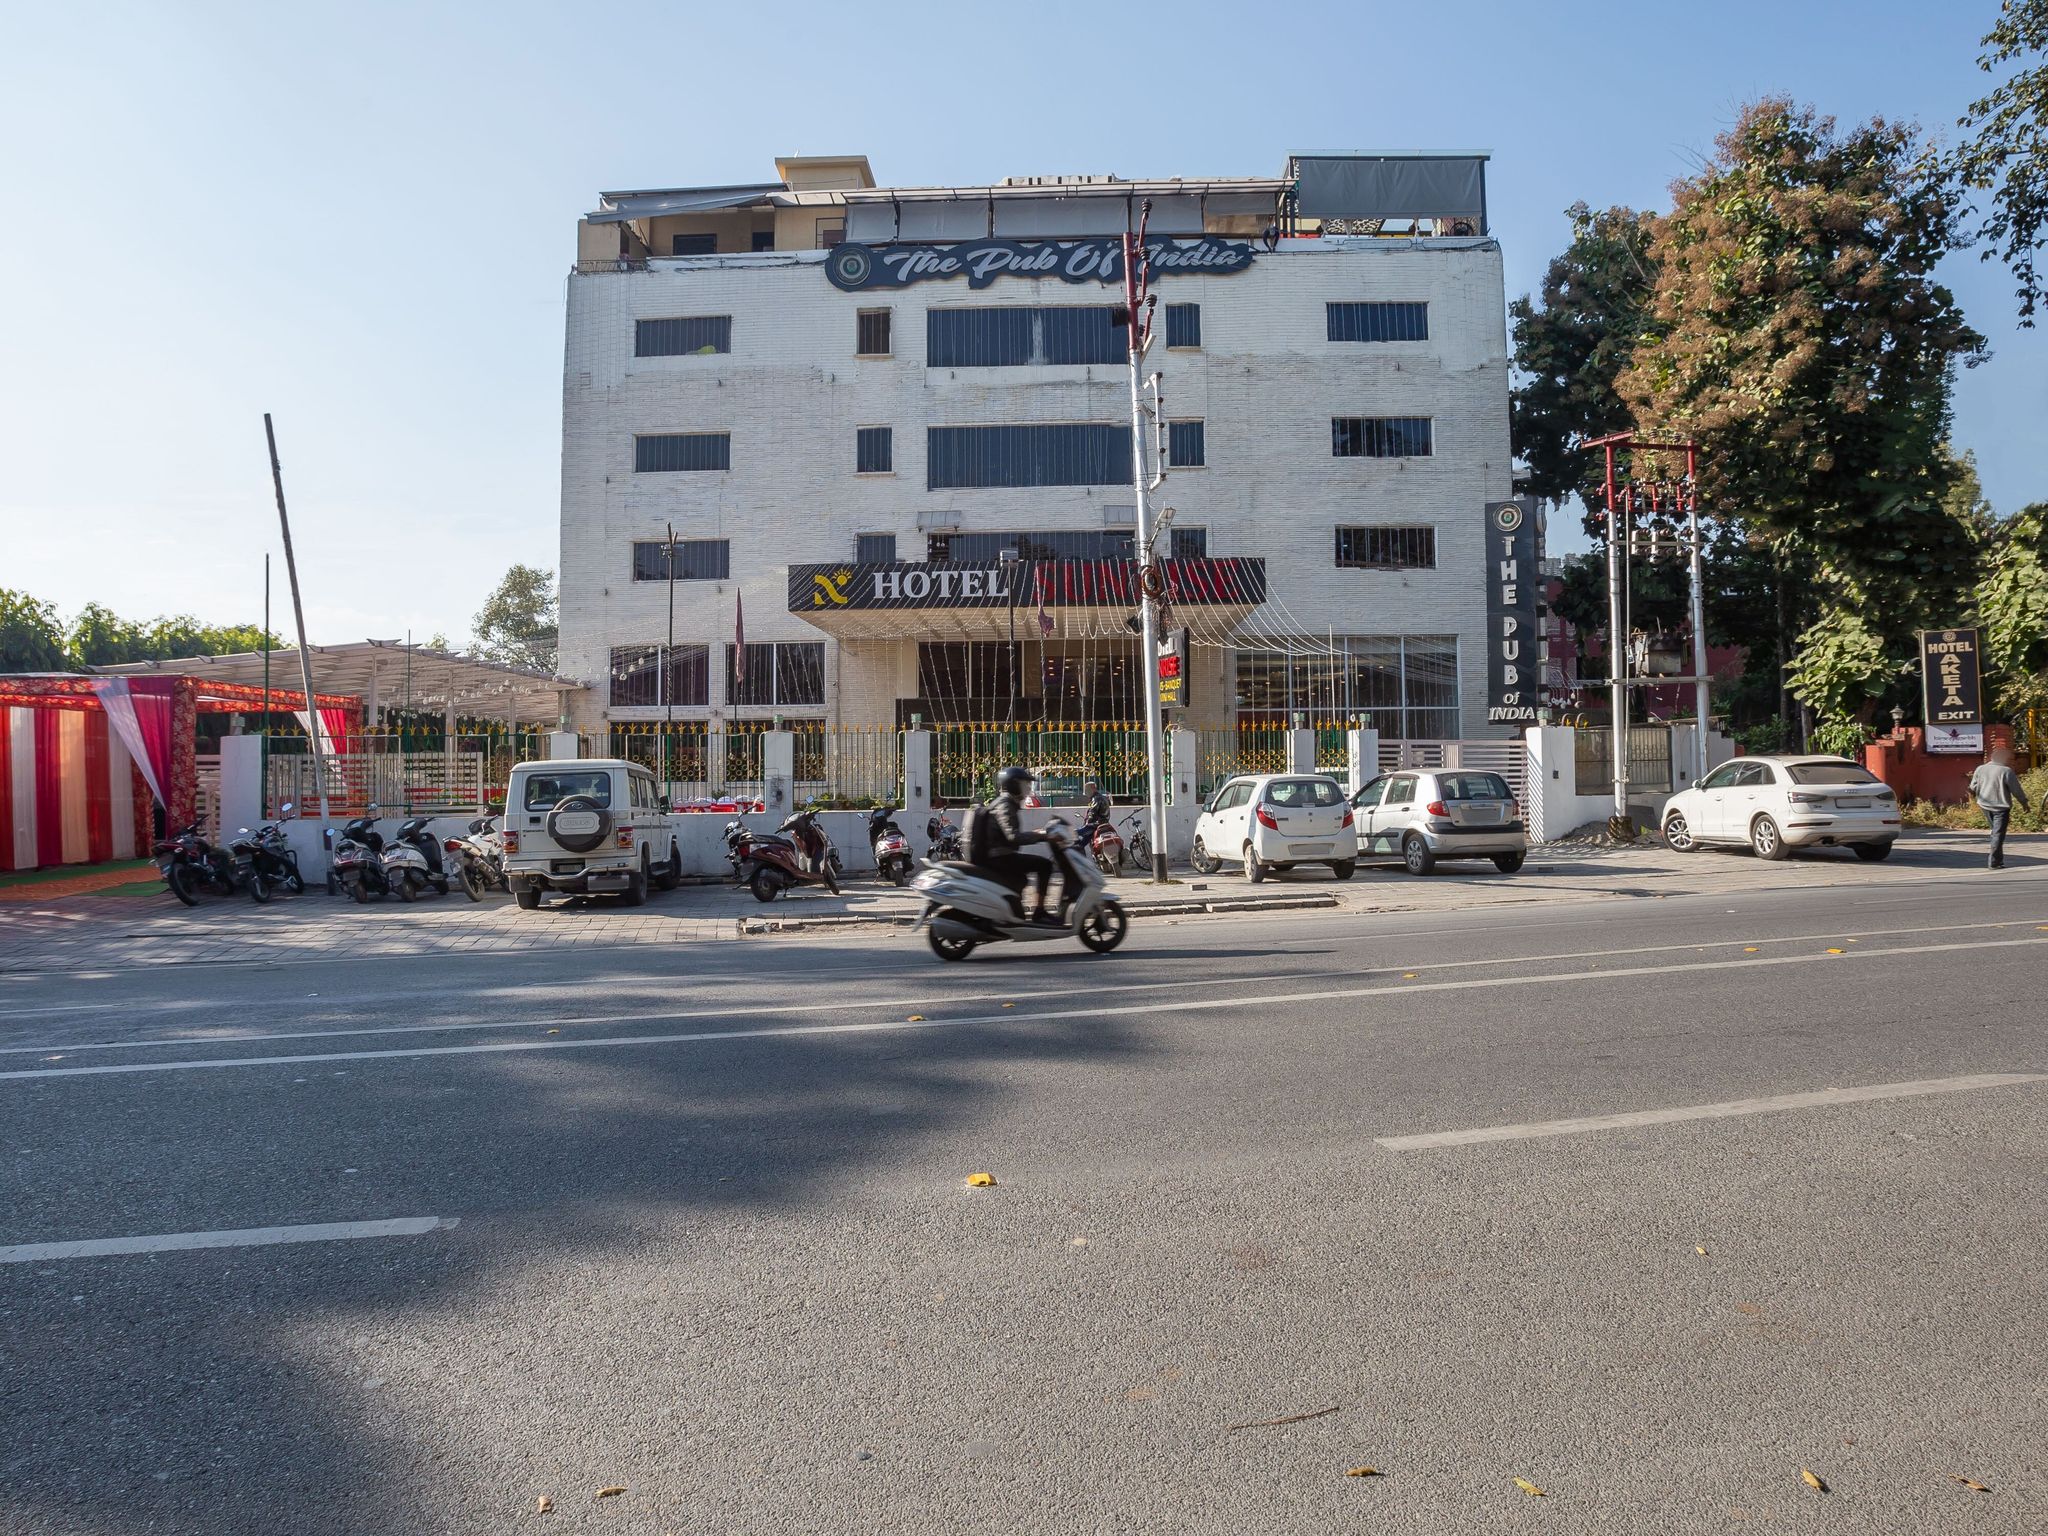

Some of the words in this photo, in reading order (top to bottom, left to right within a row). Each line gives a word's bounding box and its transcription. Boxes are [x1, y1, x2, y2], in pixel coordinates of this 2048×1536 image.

[884, 251, 962, 282] The
[967, 247, 1060, 280] Pub
[1066, 241, 1121, 277] Of
[873, 570, 1009, 600] HOTEL
[1034, 560, 1239, 601] SUNISE
[1500, 536, 1517, 605] THE
[1157, 637, 1175, 657] OEL
[1503, 616, 1519, 685] PUB
[1928, 641, 1974, 654] HOTEL
[1940, 654, 1964, 706] AKETA
[1488, 706, 1536, 720] INDIA
[1503, 692, 1520, 705] of
[1937, 710, 1975, 720] EXIT
